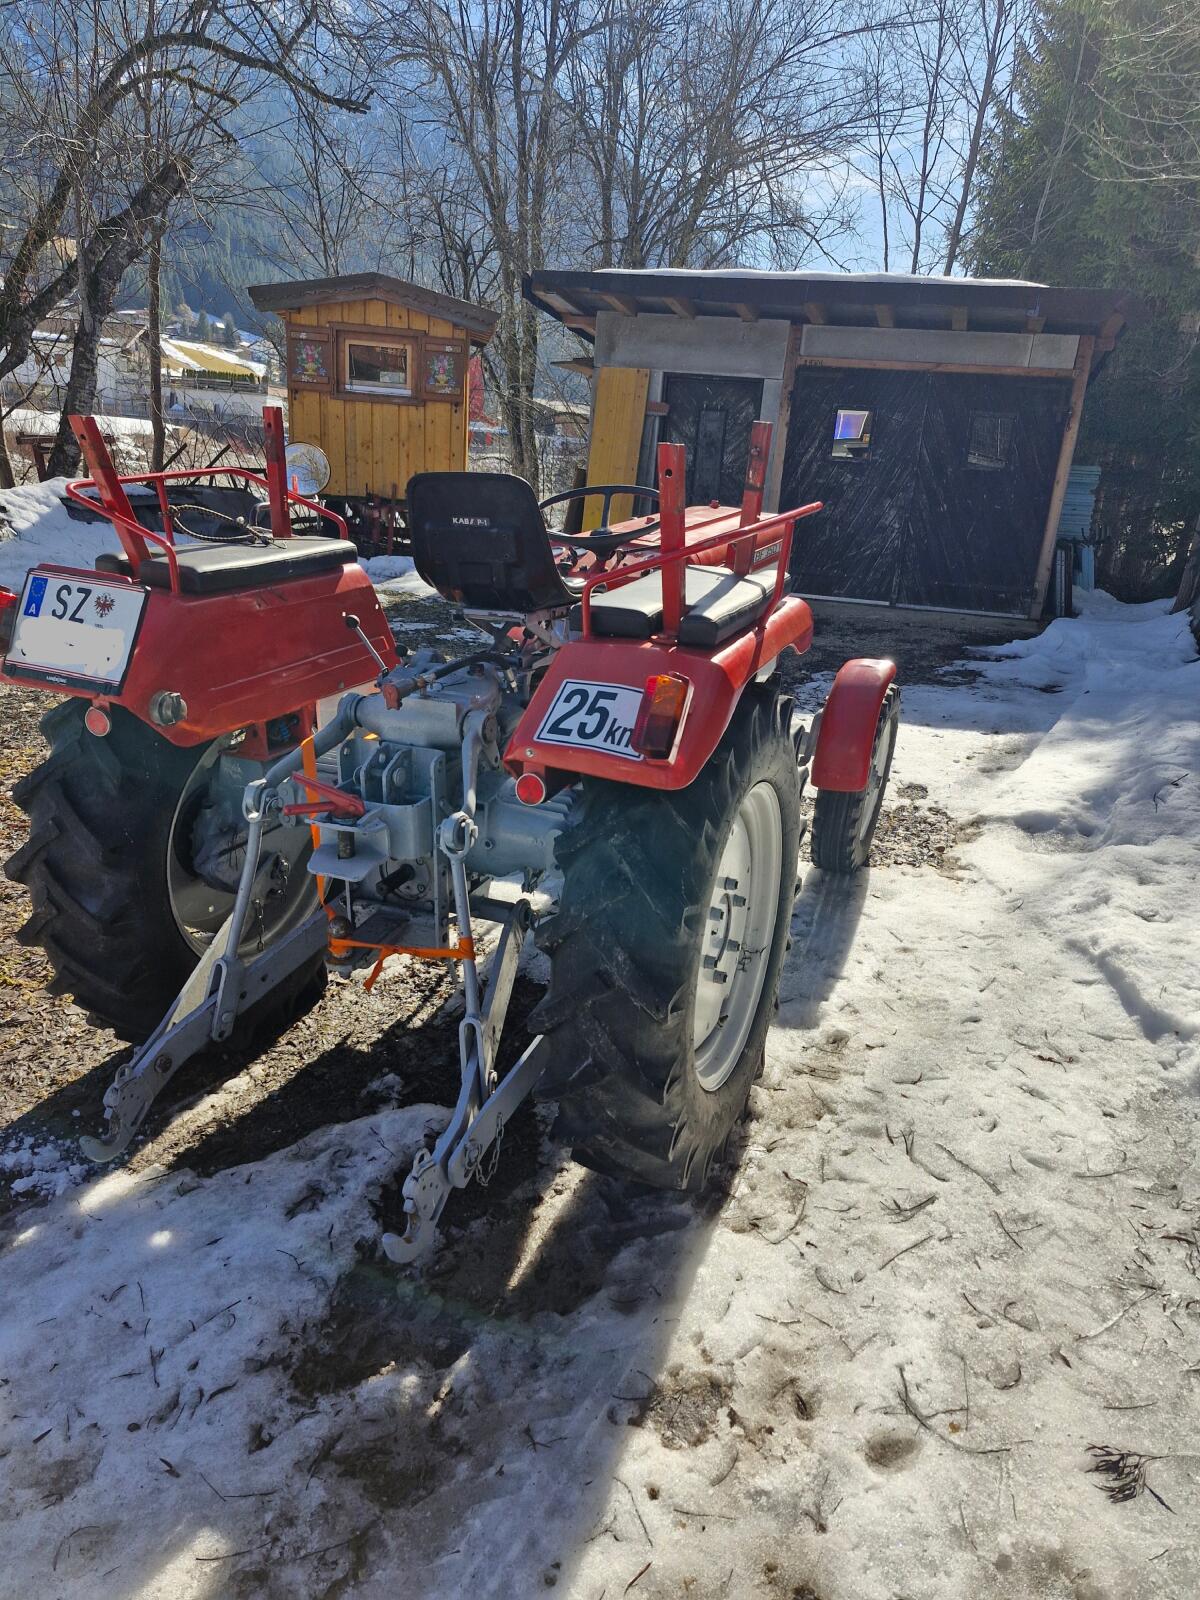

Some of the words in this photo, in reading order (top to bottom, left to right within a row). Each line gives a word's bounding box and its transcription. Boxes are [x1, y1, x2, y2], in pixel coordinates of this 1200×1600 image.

[28, 603, 36, 614] A
[52, 584, 92, 624] SZ
[547, 688, 618, 740] 25
